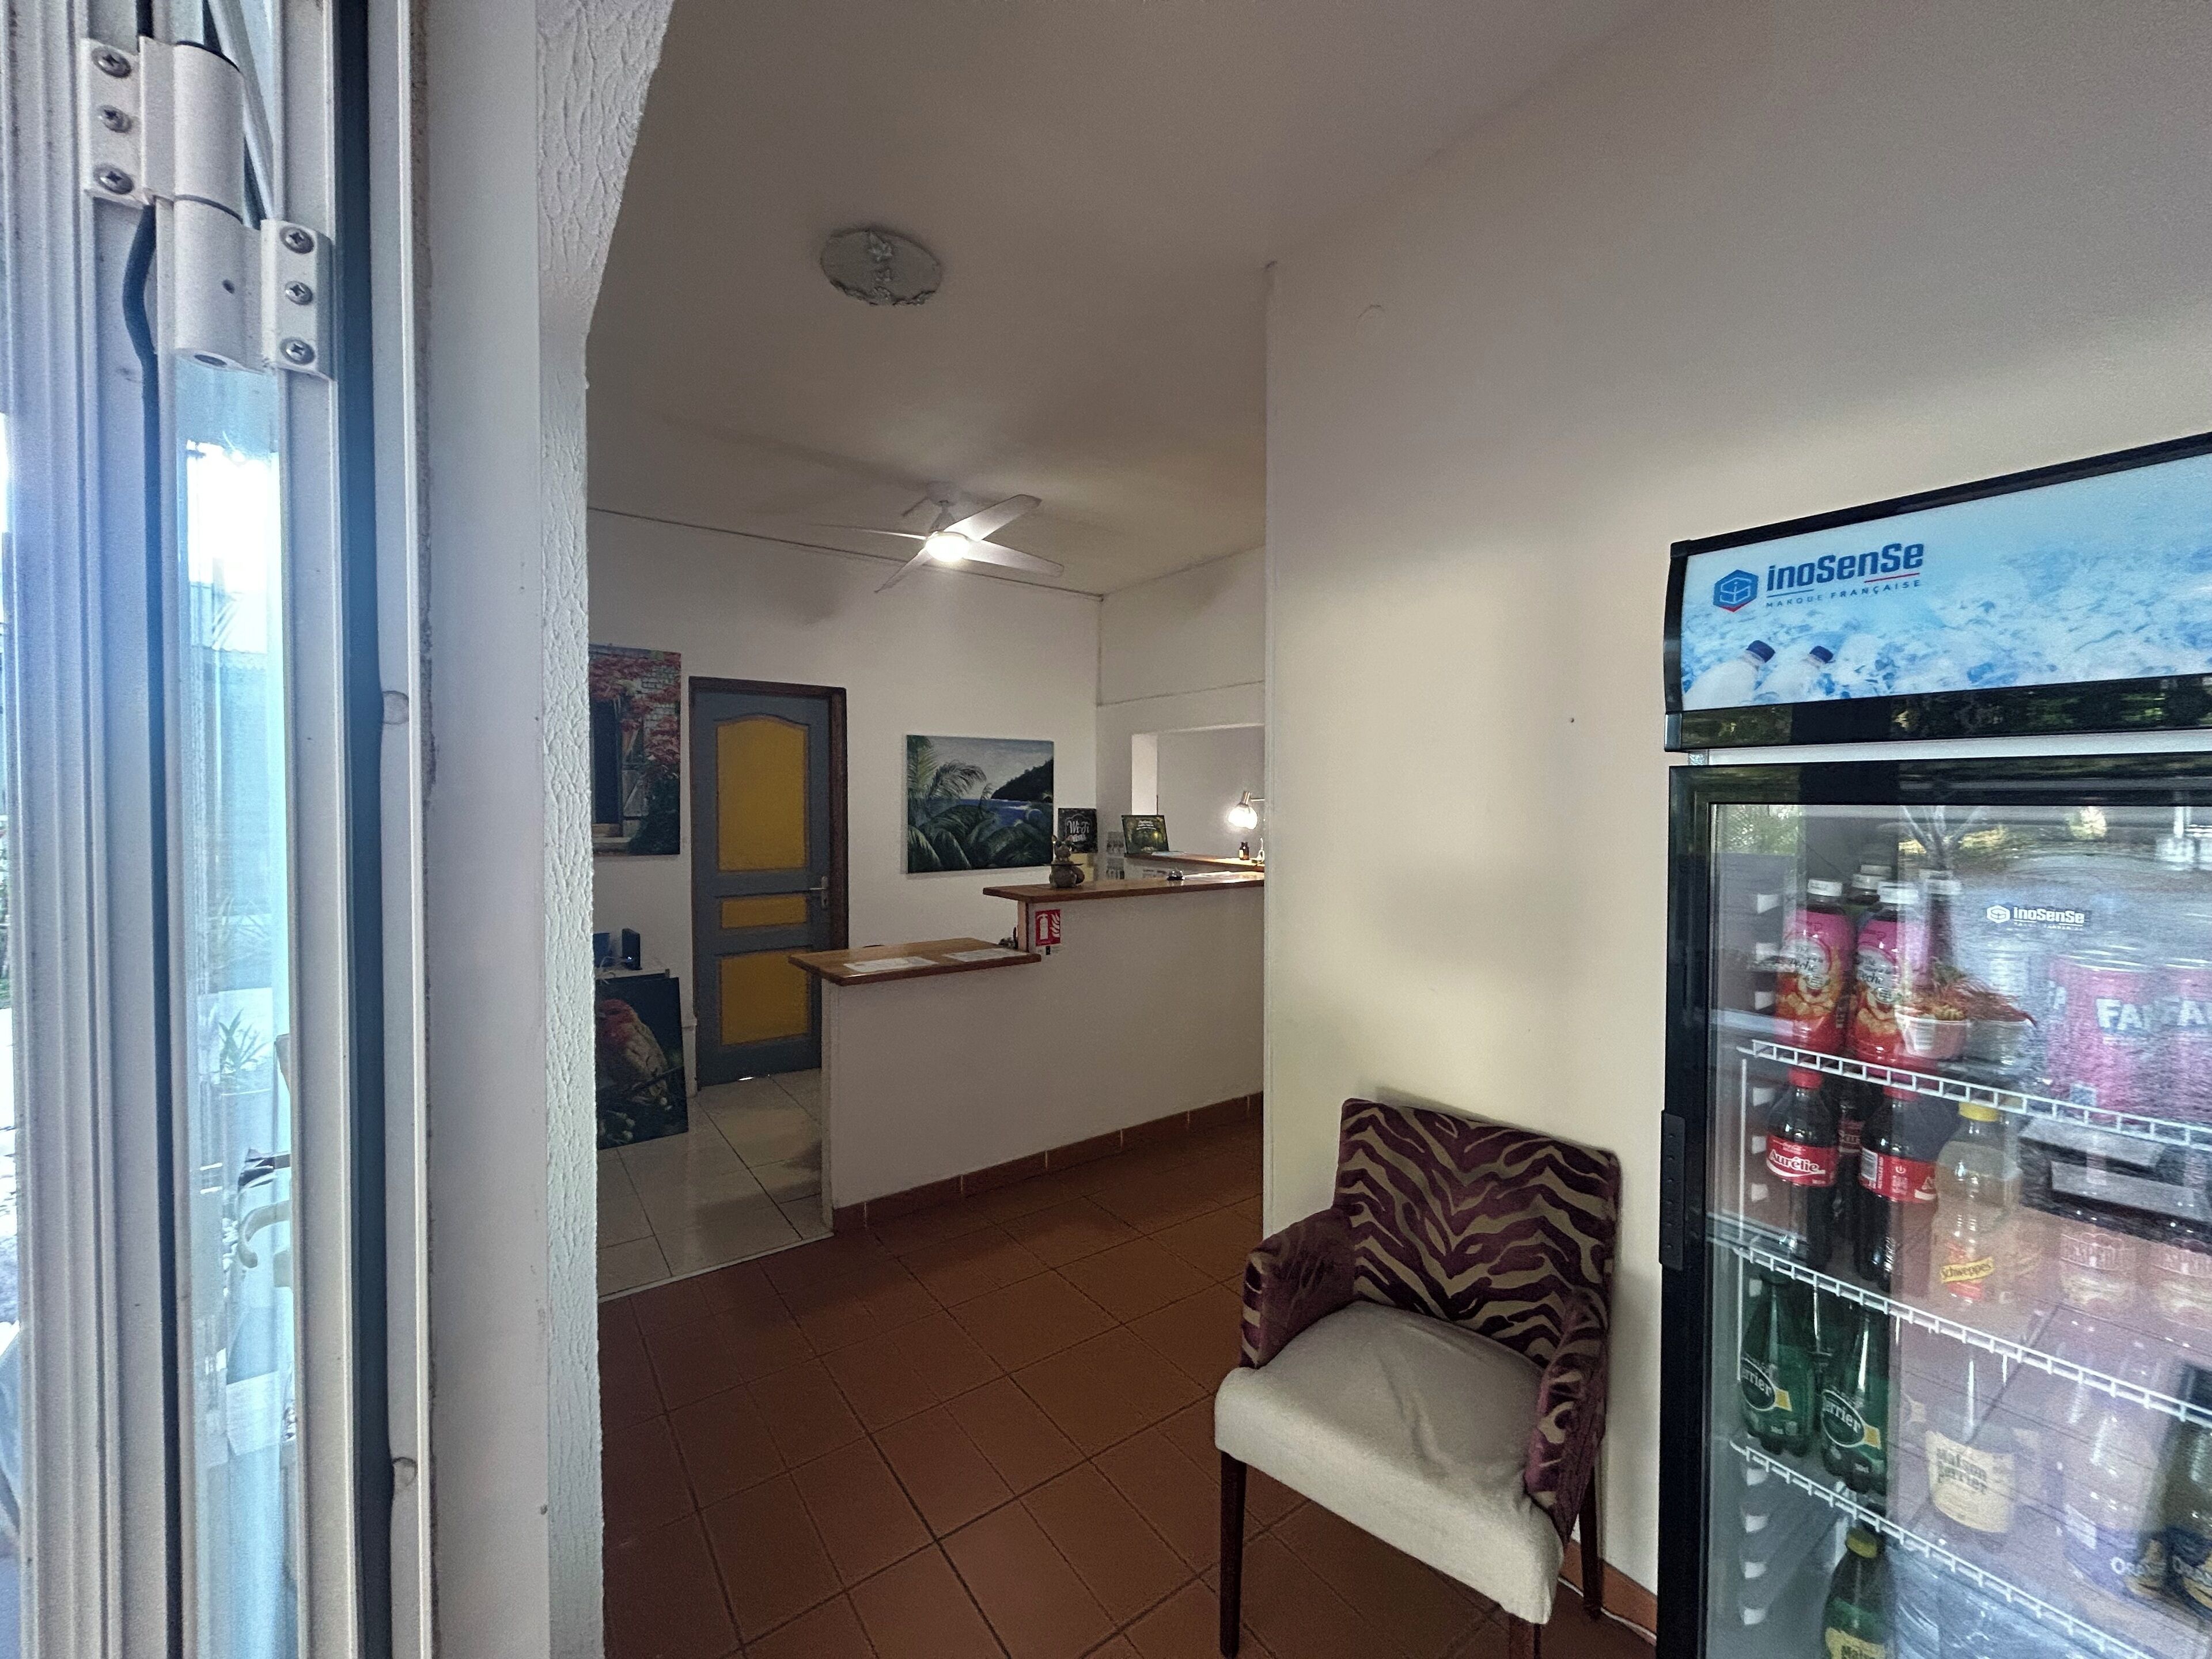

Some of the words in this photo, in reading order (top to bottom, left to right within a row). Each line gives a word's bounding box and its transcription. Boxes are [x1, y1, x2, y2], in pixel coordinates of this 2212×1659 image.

[1765, 593, 1823, 609] MARQUE
[1830, 578, 1922, 600] FRANÇAISE
[1768, 1149, 1821, 1173] Aurélie
